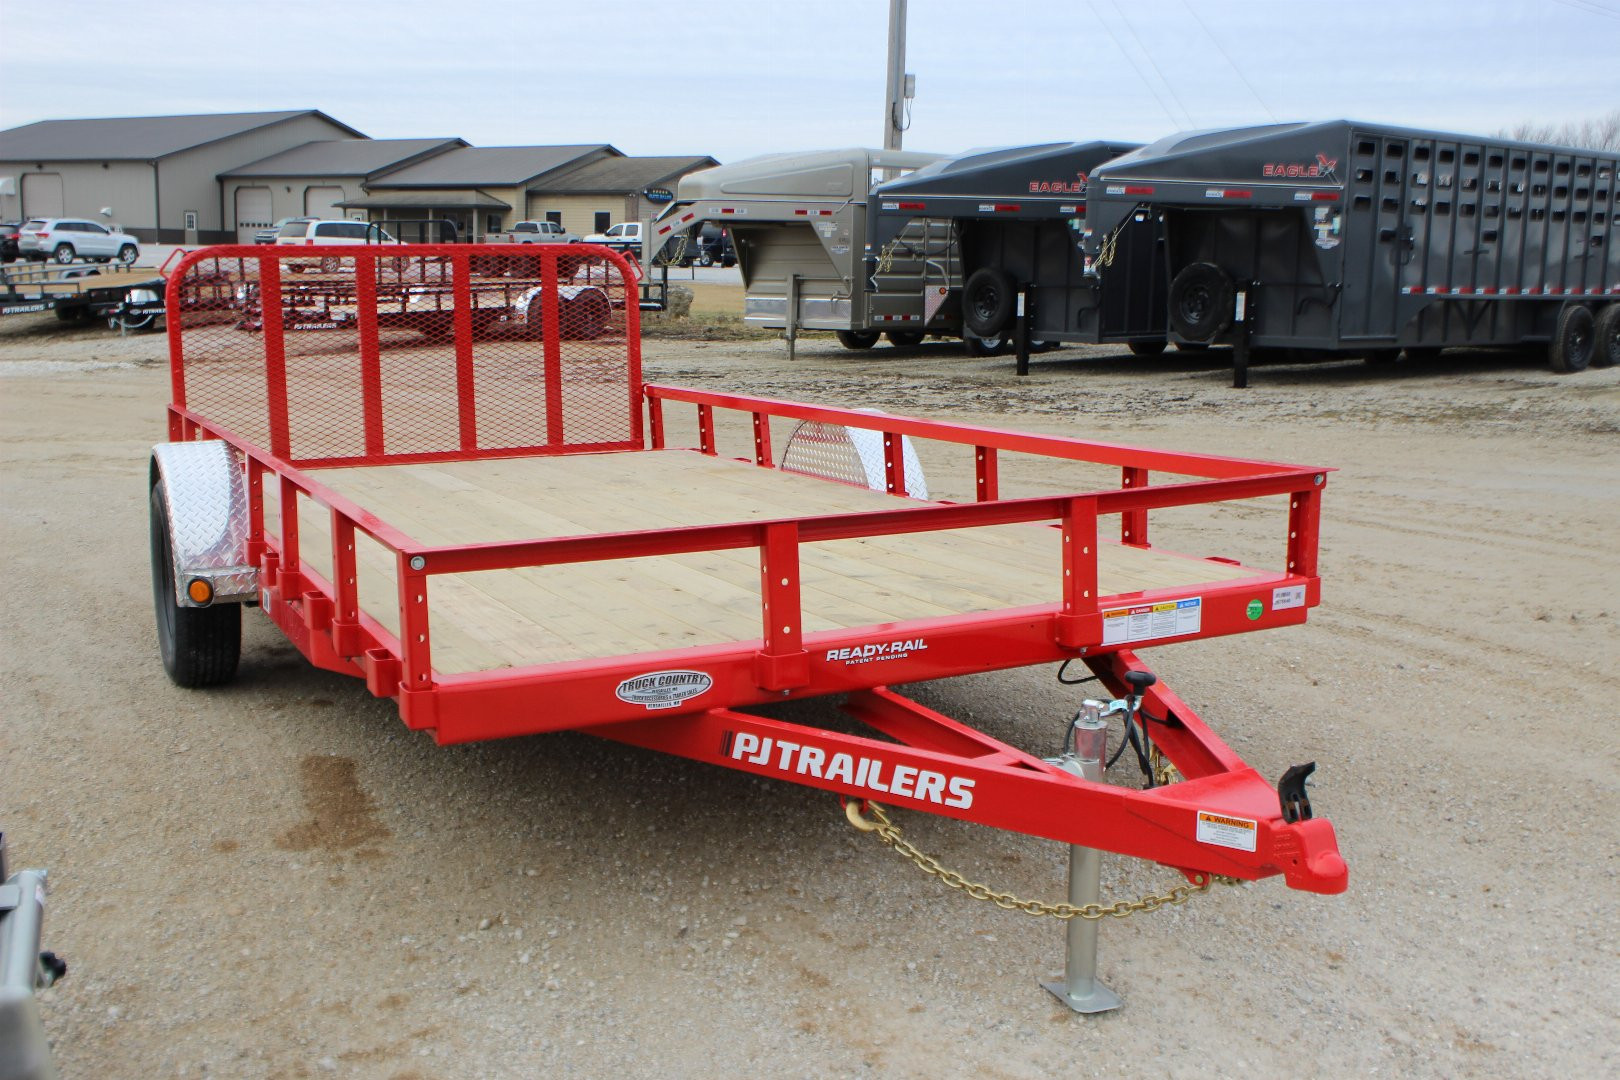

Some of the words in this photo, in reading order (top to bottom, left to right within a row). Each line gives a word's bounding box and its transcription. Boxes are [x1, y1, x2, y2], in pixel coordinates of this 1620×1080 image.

[1263, 164, 1319, 177] EAGLE
[1029, 182, 1081, 193] EAGLE
[826, 639, 928, 662] READY-RAIL
[845, 657, 873, 665] PATENT
[876, 653, 908, 661] PENDING
[622, 677, 656, 693] TRUCK
[659, 674, 706, 686] COUNTRY
[1214, 815, 1249, 828] WARNING
